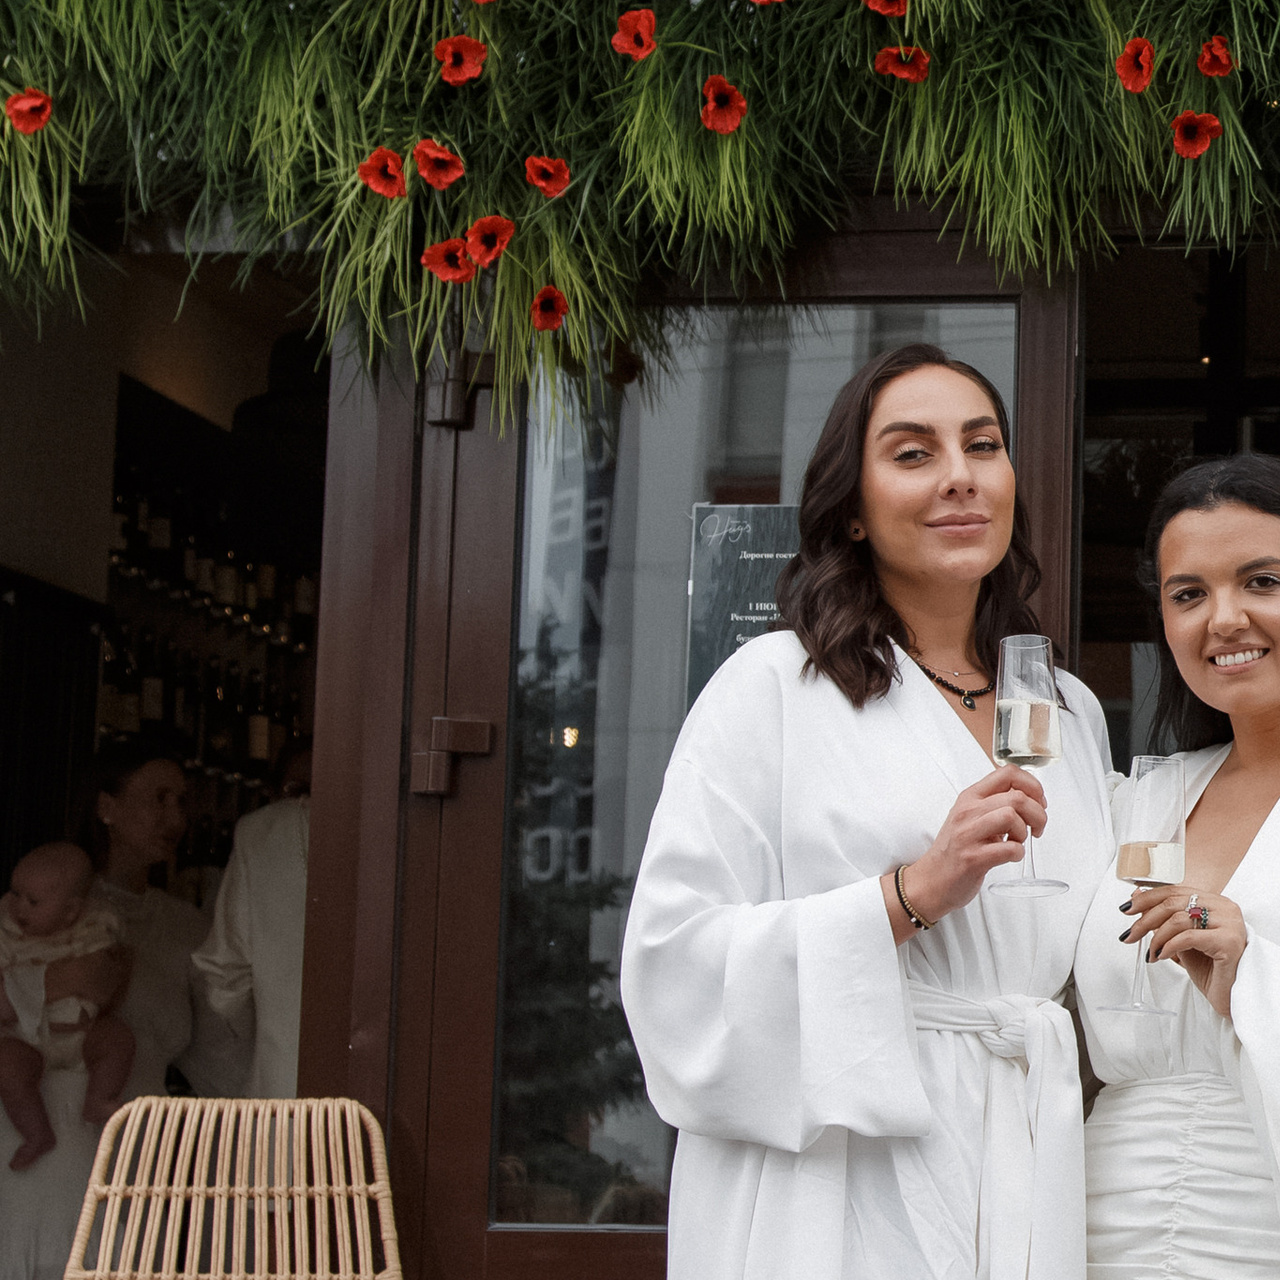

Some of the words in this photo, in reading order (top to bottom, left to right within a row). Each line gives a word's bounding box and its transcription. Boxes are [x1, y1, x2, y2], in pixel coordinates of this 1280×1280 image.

[700, 514, 751, 546] Hugs
[740, 551, 774, 560] Дорогие
[731, 613, 767, 623] Ресторан
